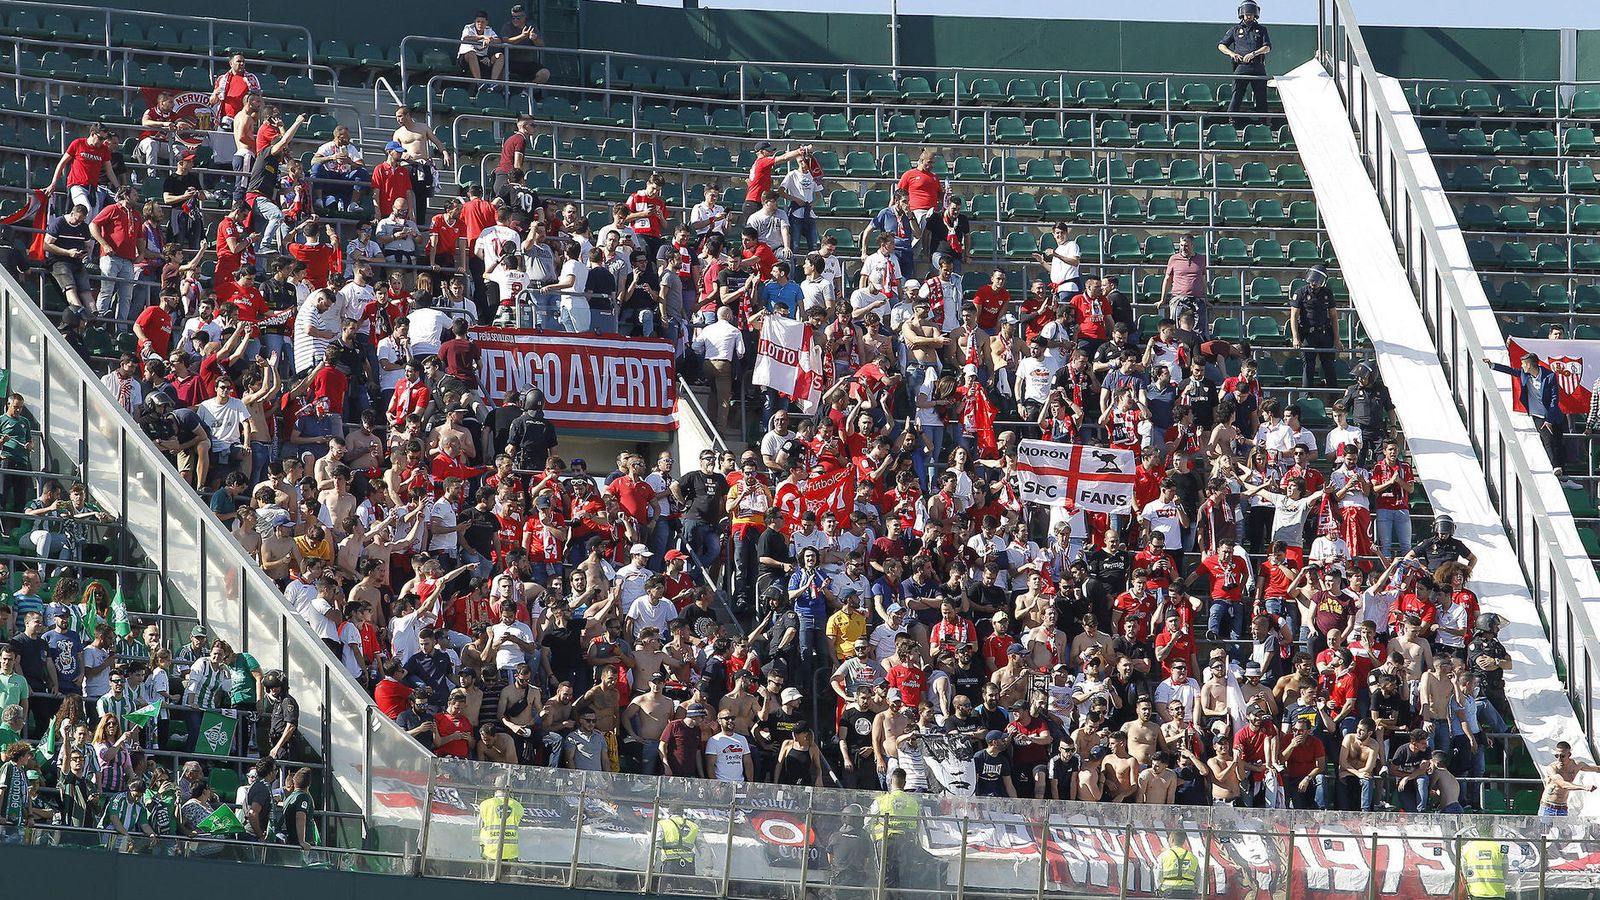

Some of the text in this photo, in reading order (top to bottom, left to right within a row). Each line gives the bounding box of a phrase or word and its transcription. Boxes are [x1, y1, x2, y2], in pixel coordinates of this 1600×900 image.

[760, 340, 796, 364] LOTTO
[567, 353, 586, 404] A
[590, 355, 674, 409] VERTE
[1020, 446, 1069, 460] MORÓN
[1023, 481, 1128, 506] SFC FANS
[982, 762, 1003, 776] EVERLAST
